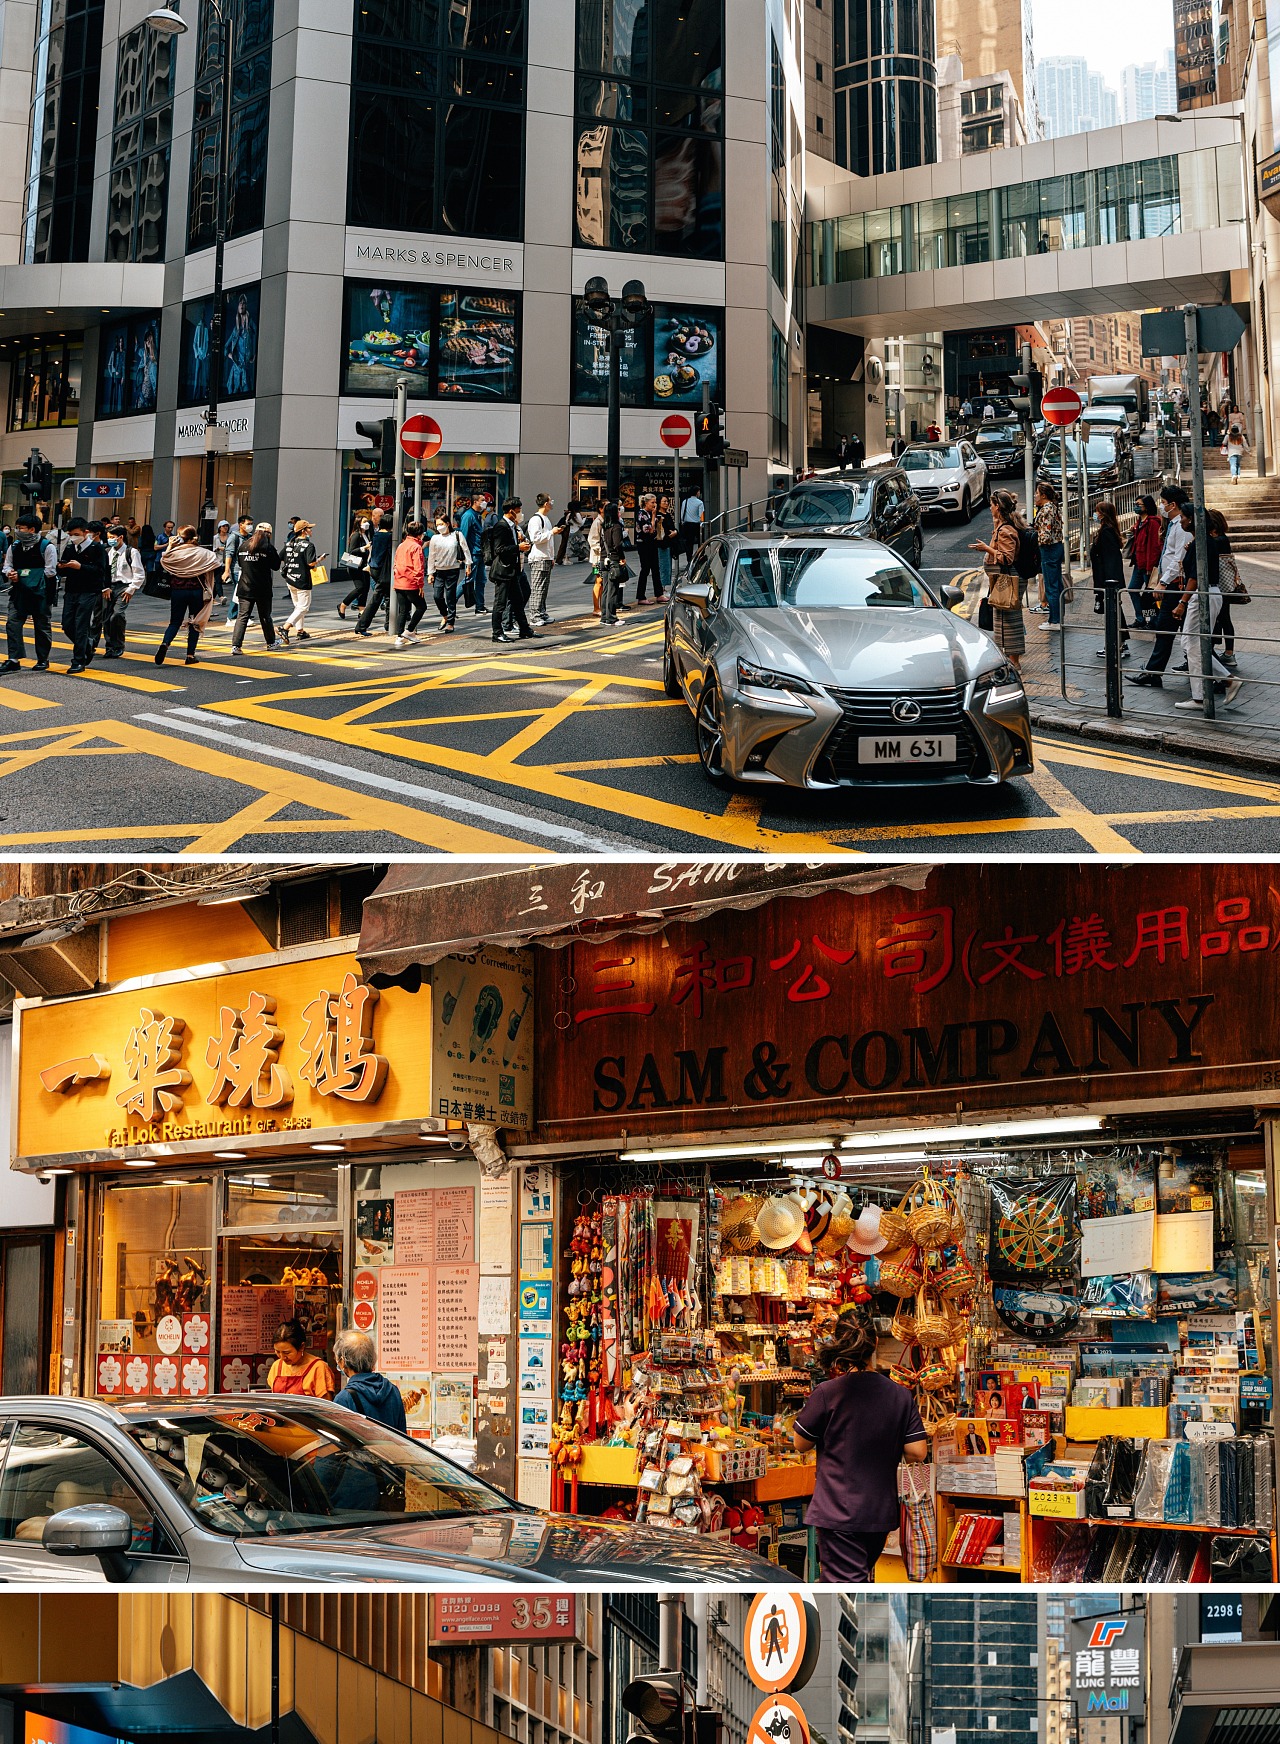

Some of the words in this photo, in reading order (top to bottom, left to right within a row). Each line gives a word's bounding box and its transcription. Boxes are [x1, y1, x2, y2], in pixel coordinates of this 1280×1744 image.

[357, 245, 417, 263] MARKS
[421, 251, 431, 264] &
[434, 253, 513, 272] SPENCER
[875, 741, 900, 758] MM
[910, 740, 941, 757] 631
[518, 869, 605, 915] 三和
[593, 1045, 729, 1112] SAM
[743, 1040, 792, 1099] &
[804, 993, 1215, 1095] COMPANY
[104, 1128, 126, 1147] Yat
[130, 1126, 157, 1143] Lok
[163, 1114, 250, 1141] Restaurant
[1157, 1301, 1197, 1312] LASTER
[157, 1333, 180, 1341] MICHELIN
[1034, 1492, 1058, 1502] 2023
[441, 1615, 500, 1624] www.angelface.com.hk
[511, 1597, 552, 1630] 35
[556, 1598, 569, 1627] 週年
[1207, 1604, 1231, 1618] 2298
[1075, 1648, 1140, 1677] 龍豐
[1076, 1678, 1105, 1688] LUNG
[1110, 1677, 1140, 1687] FUNG
[1087, 1689, 1129, 1712] Mall
